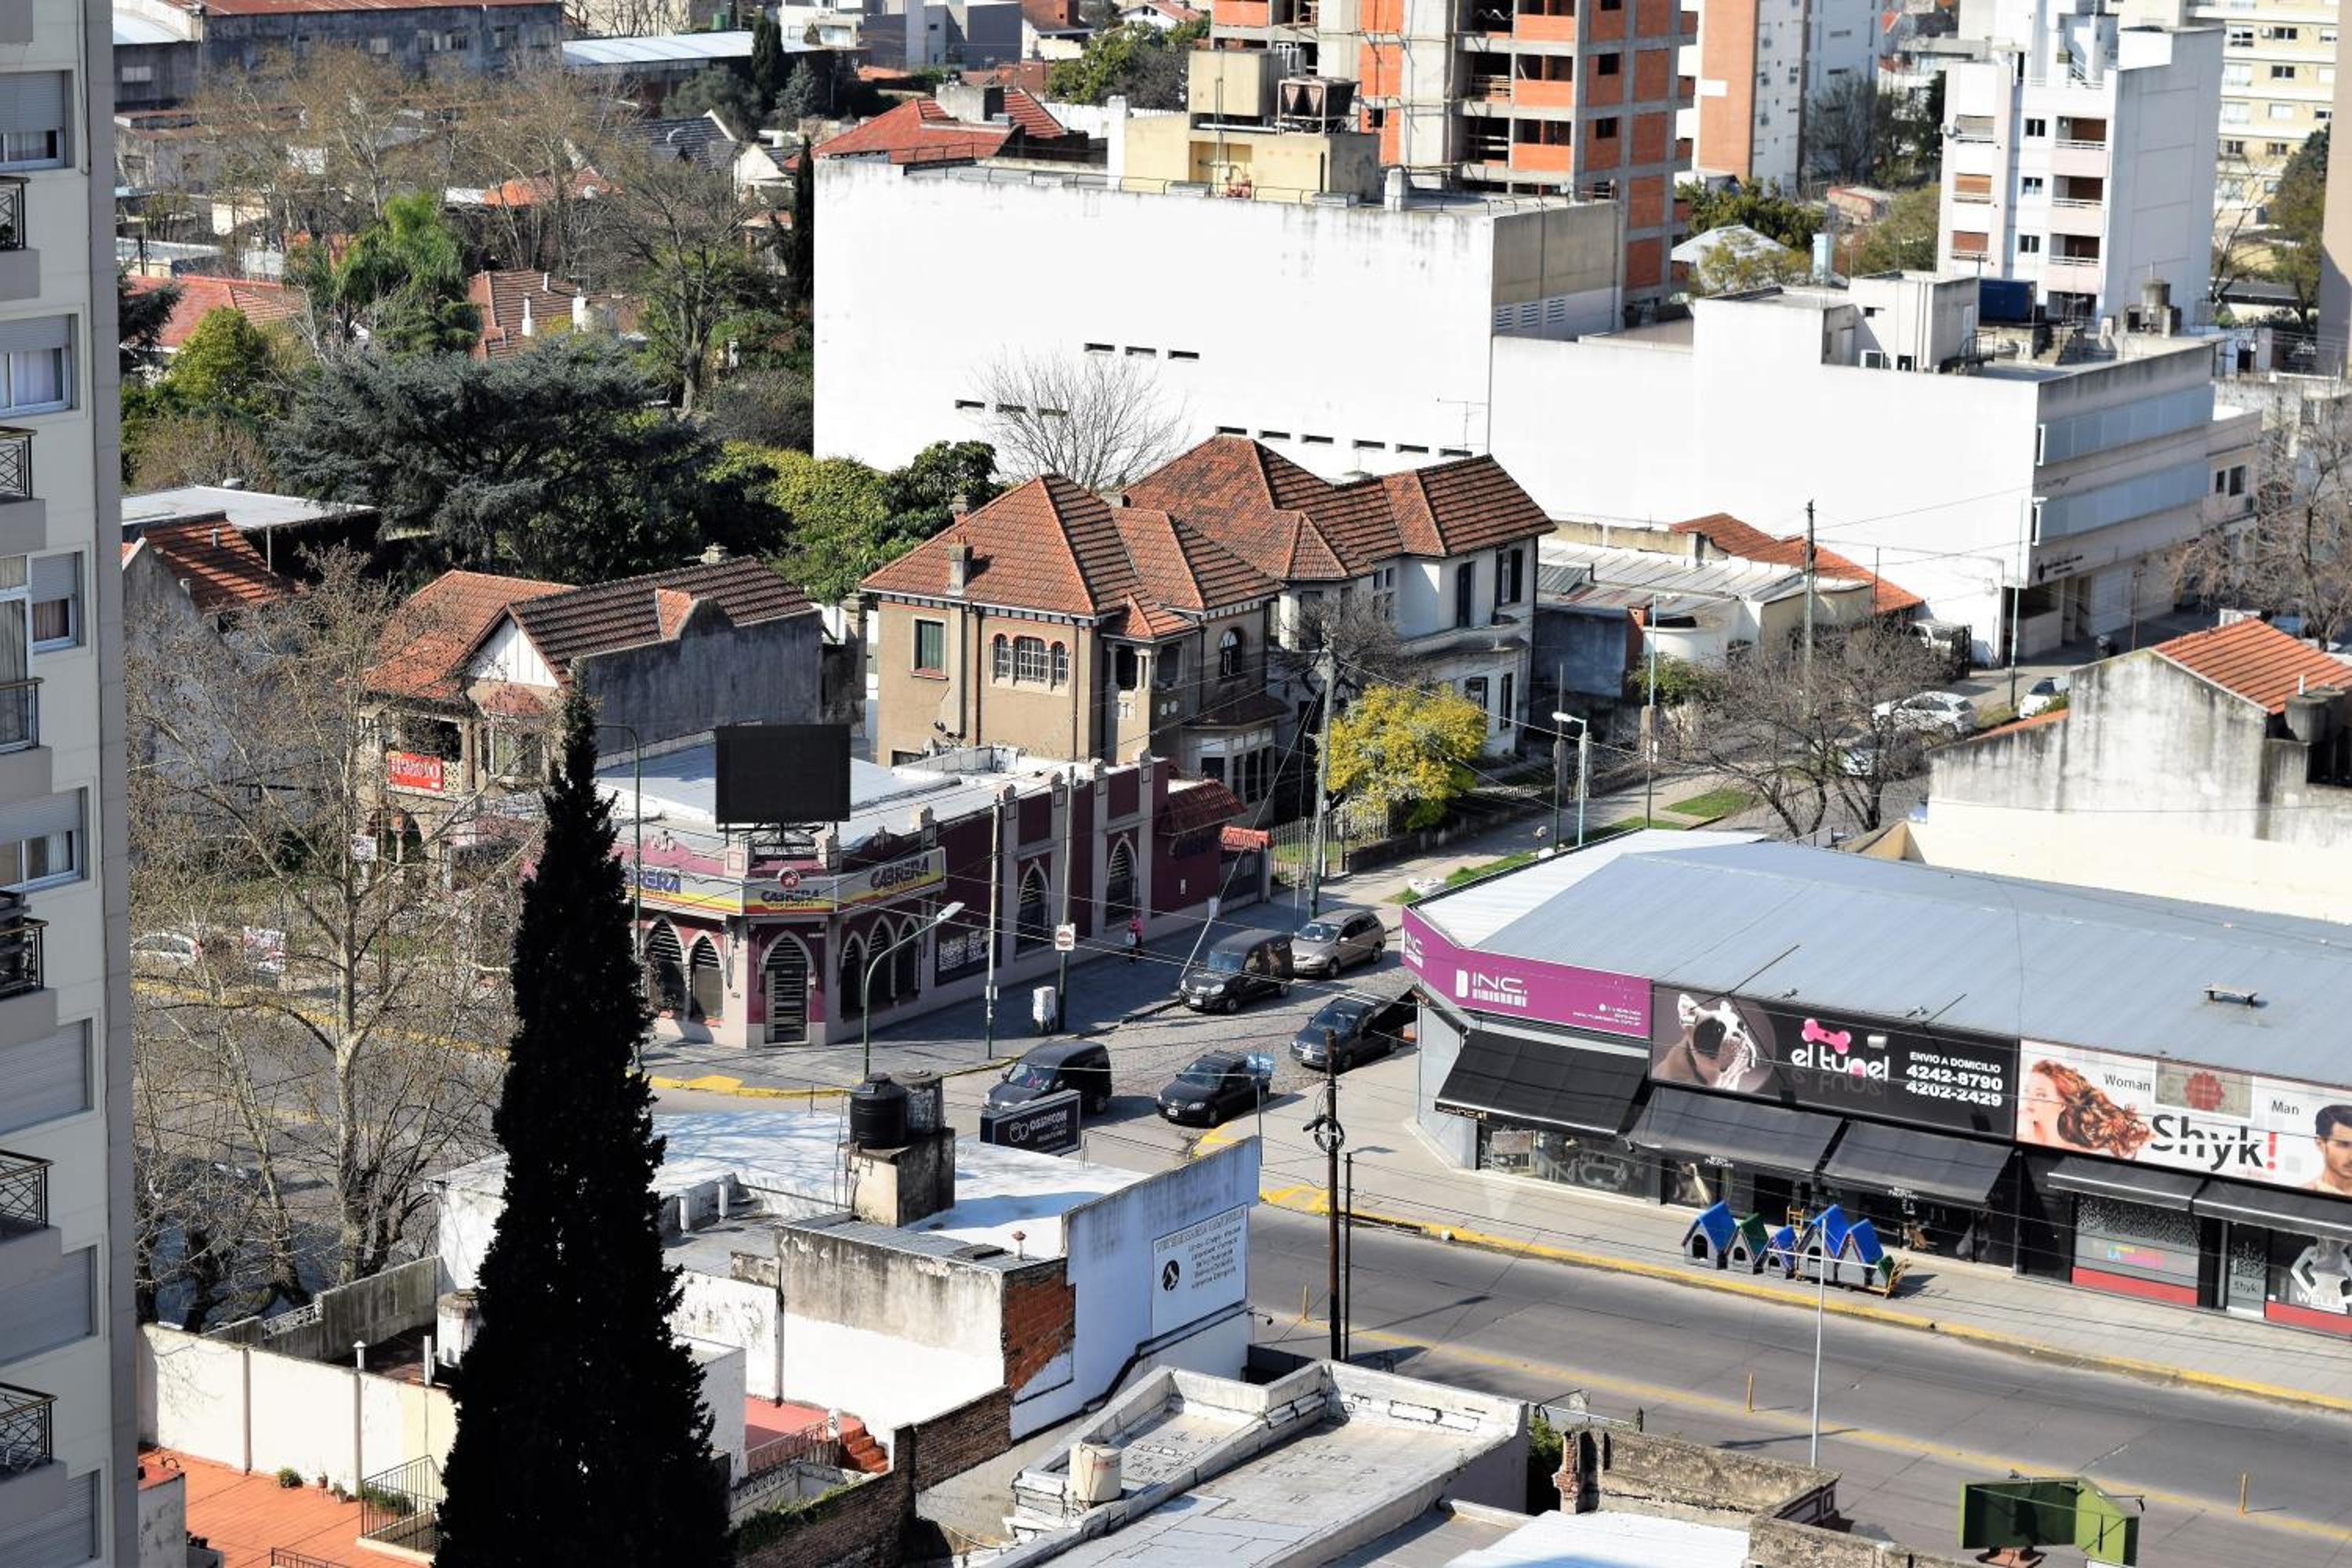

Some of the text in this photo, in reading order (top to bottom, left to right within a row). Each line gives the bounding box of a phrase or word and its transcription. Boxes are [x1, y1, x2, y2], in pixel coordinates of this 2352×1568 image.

[869, 857, 930, 890] CABRERA
[760, 889, 820, 903] CABRERA
[1790, 1044, 1813, 1069] el
[1909, 1051, 2002, 1074] ENVIO A DOMICILIO
[1905, 1064, 2003, 1091] 4242-8790
[2103, 1073, 2151, 1092] Woman
[1905, 1080, 2003, 1108] 4202-2429
[2270, 1098, 2300, 1116] Man
[2151, 1113, 2277, 1171] Shyk!
